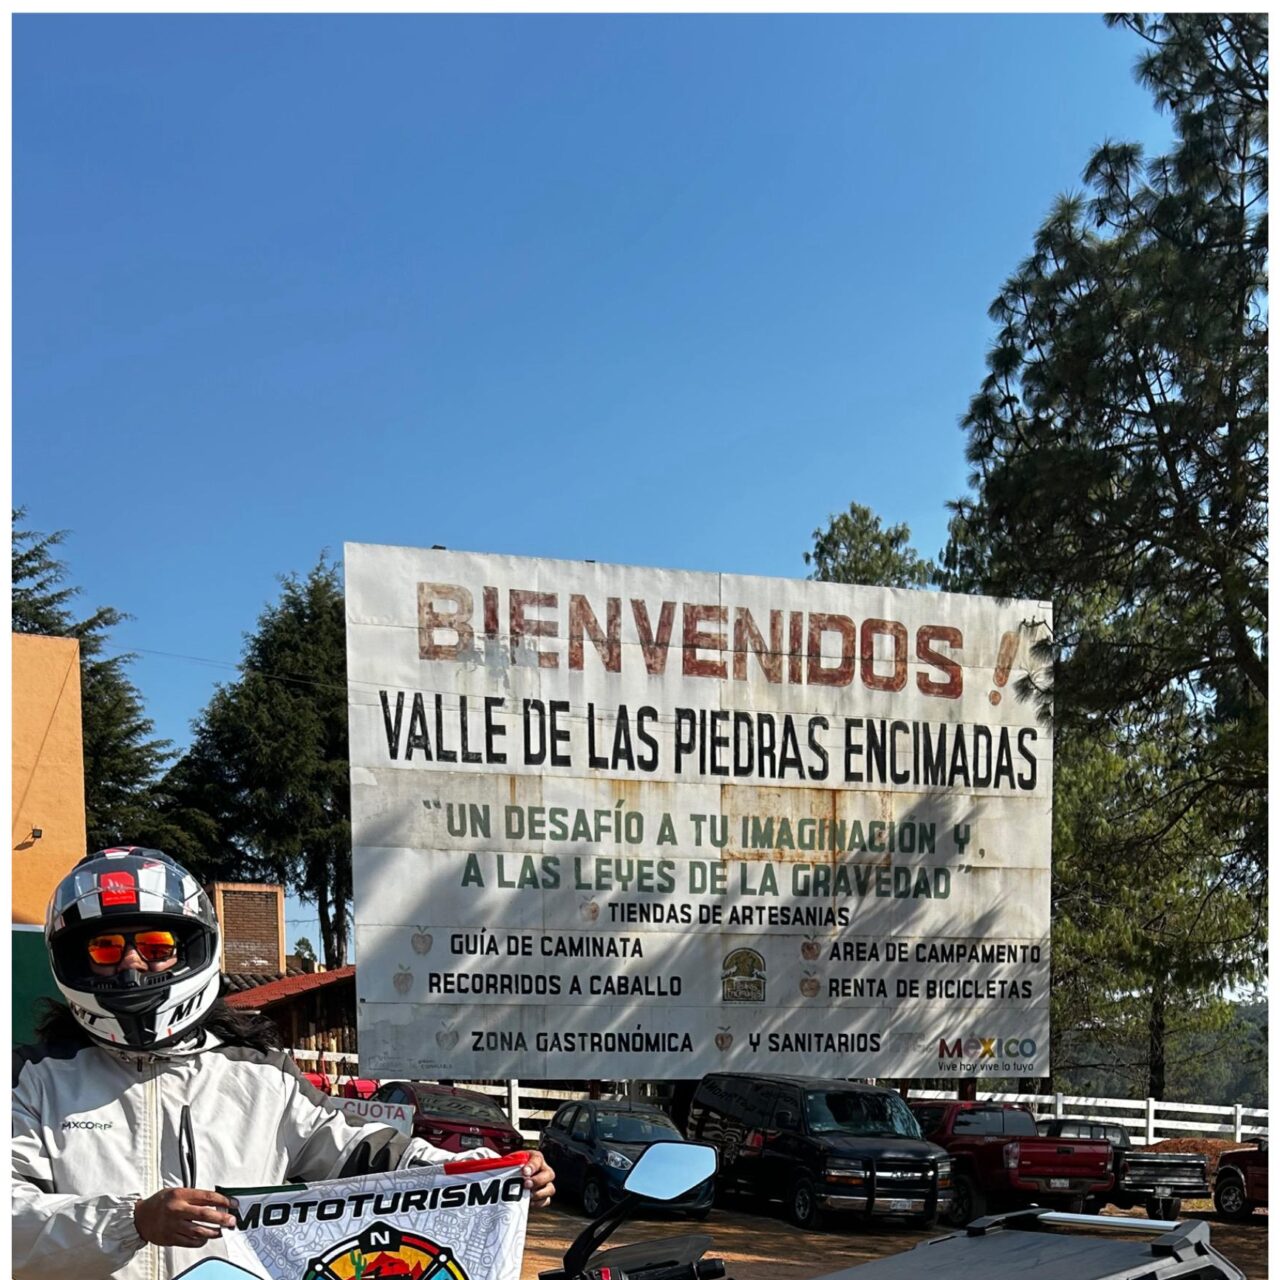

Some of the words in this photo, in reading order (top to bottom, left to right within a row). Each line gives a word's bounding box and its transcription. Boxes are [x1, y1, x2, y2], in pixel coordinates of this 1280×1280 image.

[417, 582, 964, 700] BIENVENIDOS
[379, 690, 507, 764] VALLE
[523, 698, 571, 768] DE
[587, 704, 659, 773] LAS
[674, 706, 829, 781] PIEDRAS
[844, 718, 1038, 791] ENCIMADAS
[505, 800, 644, 845] DESAFÍO
[657, 812, 678, 845] A
[690, 813, 729, 846] TU
[741, 816, 936, 854] IMAGINACIÓN
[461, 853, 484, 888] A
[496, 855, 560, 890] LAS
[574, 857, 675, 894] LEYES
[688, 861, 728, 895] DE
[739, 862, 779, 898] LA
[607, 901, 691, 925] TIENDAS
[698, 904, 723, 926] DE
[728, 904, 850, 928] ARTESANIAS
[450, 927, 500, 957] GUÍA
[506, 935, 533, 957] DE
[539, 935, 643, 959] CAMINATA
[885, 942, 908, 963] DE
[915, 942, 1041, 965] CAMPAMENTO
[428, 974, 559, 996] RECORRIDOS
[568, 975, 583, 996] A
[588, 974, 682, 997] CABALLO
[827, 977, 889, 999] RENTA
[896, 977, 920, 999] DE
[925, 978, 1033, 1000] BICICLETAS
[168, 984, 210, 1026] MT
[471, 1030, 529, 1052] ZONA
[536, 1024, 694, 1054] GASTRONÓMICA
[748, 1032, 761, 1052] Y
[767, 1031, 882, 1054] SANITARIOS
[980, 1062, 999, 1071] vive
[370, 1230, 391, 1246] N
